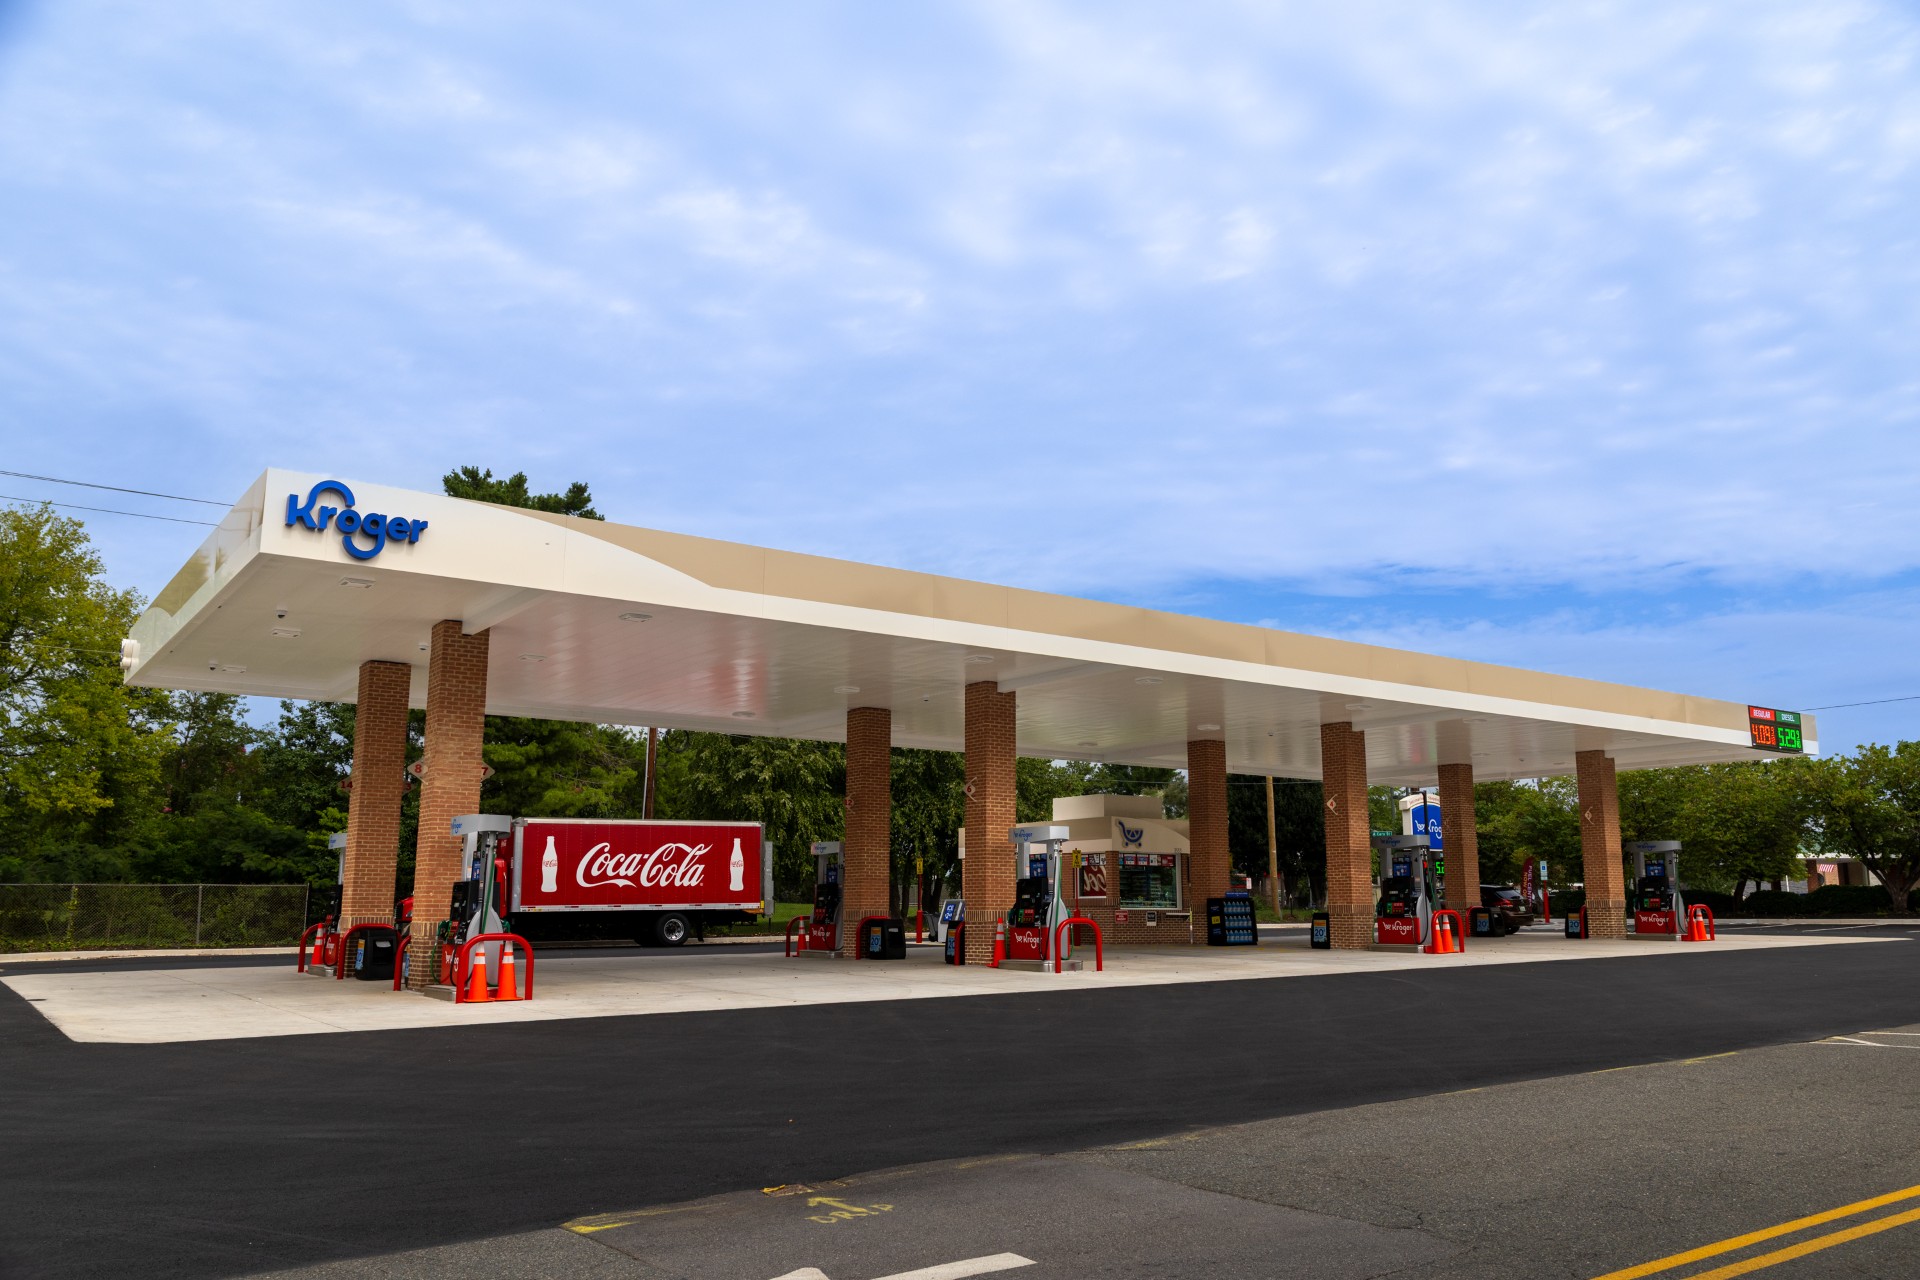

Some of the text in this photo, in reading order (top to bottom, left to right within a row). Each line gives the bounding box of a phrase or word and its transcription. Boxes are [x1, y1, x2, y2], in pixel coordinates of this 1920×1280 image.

[285, 480, 428, 560] Kroger
[1753, 709, 1771, 719] REGULAR
[1781, 713, 1795, 722] DIESEL
[1777, 727, 1796, 748] 5.29
[414, 764, 422, 773] 8
[481, 767, 489, 775] 7
[341, 781, 353, 789] 14
[1427, 819, 1442, 839] Krog
[576, 842, 713, 888] Coca-Cola
[1391, 920, 1412, 935] Kroger
[1023, 931, 1042, 949] Kroge
